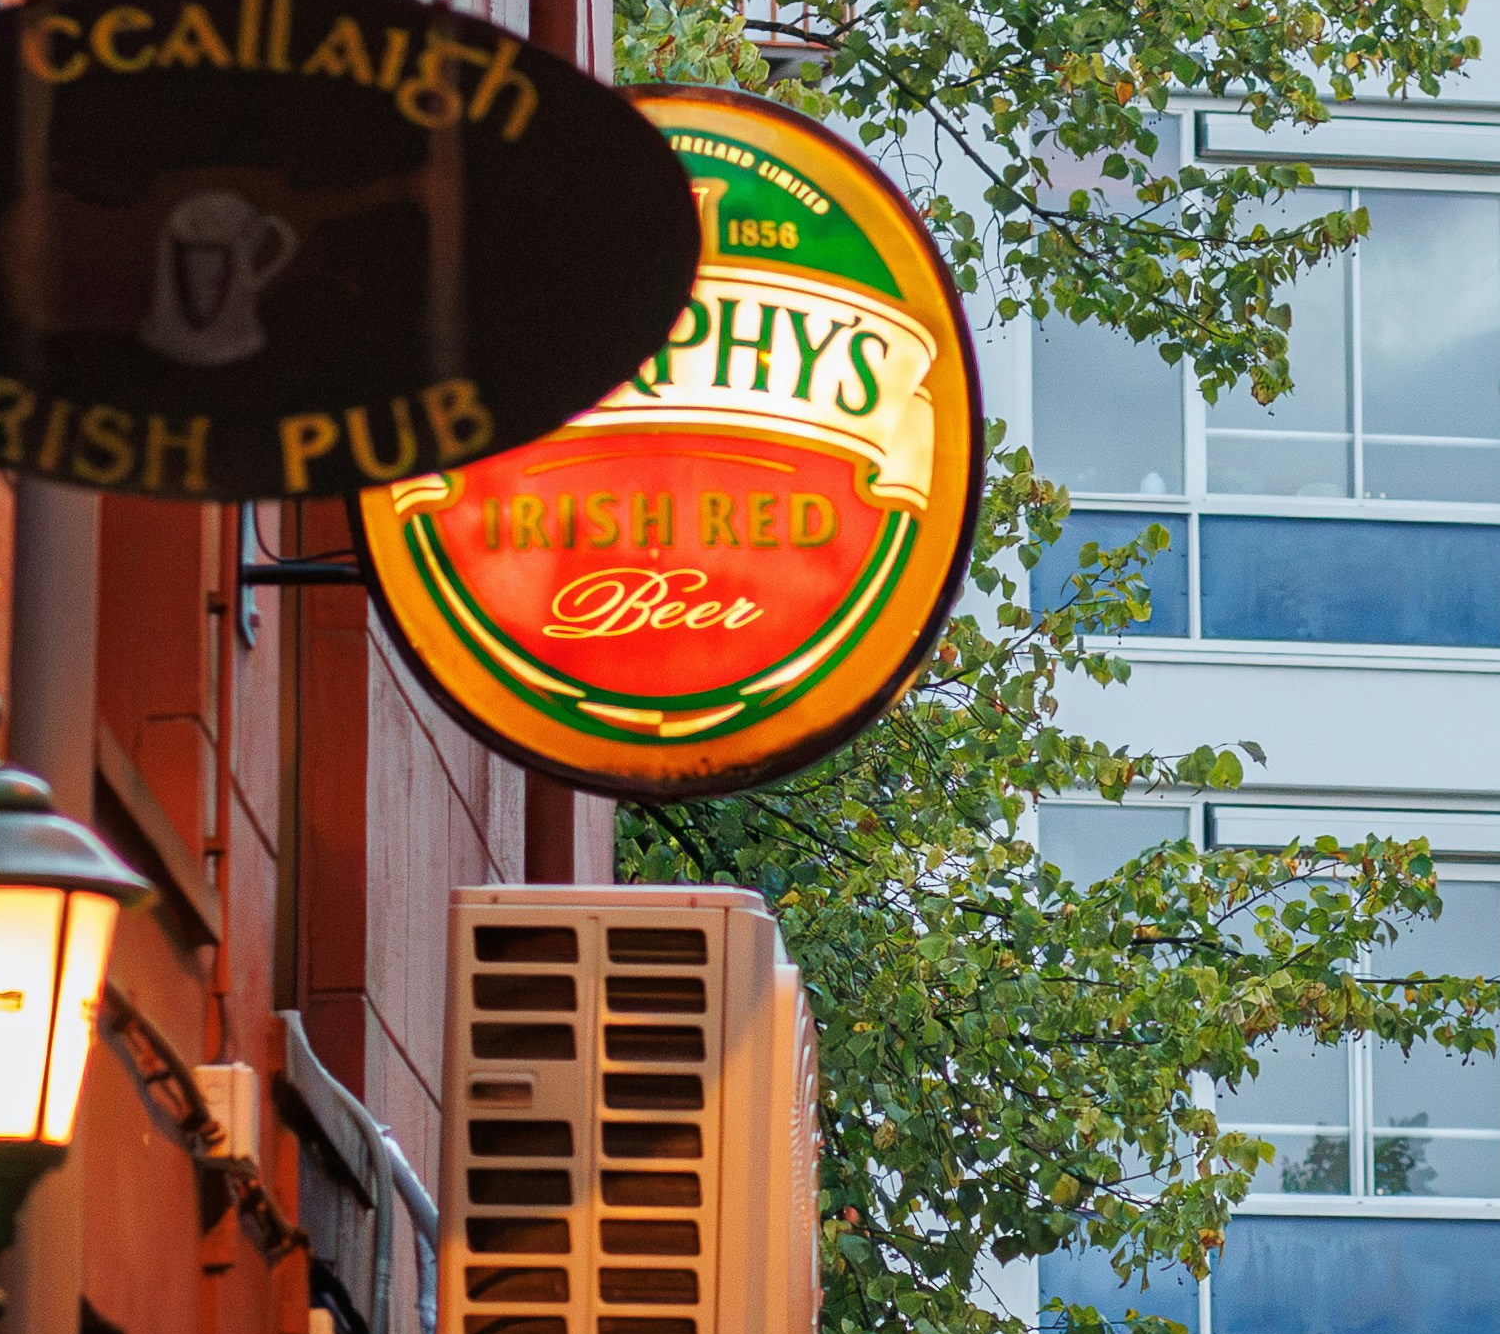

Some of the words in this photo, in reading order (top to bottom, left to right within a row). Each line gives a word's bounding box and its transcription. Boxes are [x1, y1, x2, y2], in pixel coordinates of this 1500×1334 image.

[670, 134, 756, 170] IRELAND
[757, 160, 831, 216] LIMITED
[727, 218, 799, 250] 1856
[279, 377, 496, 494] PUB
[480, 490, 676, 551] IRISH
[699, 490, 840, 549] RED
[542, 567, 764, 639] Beer
